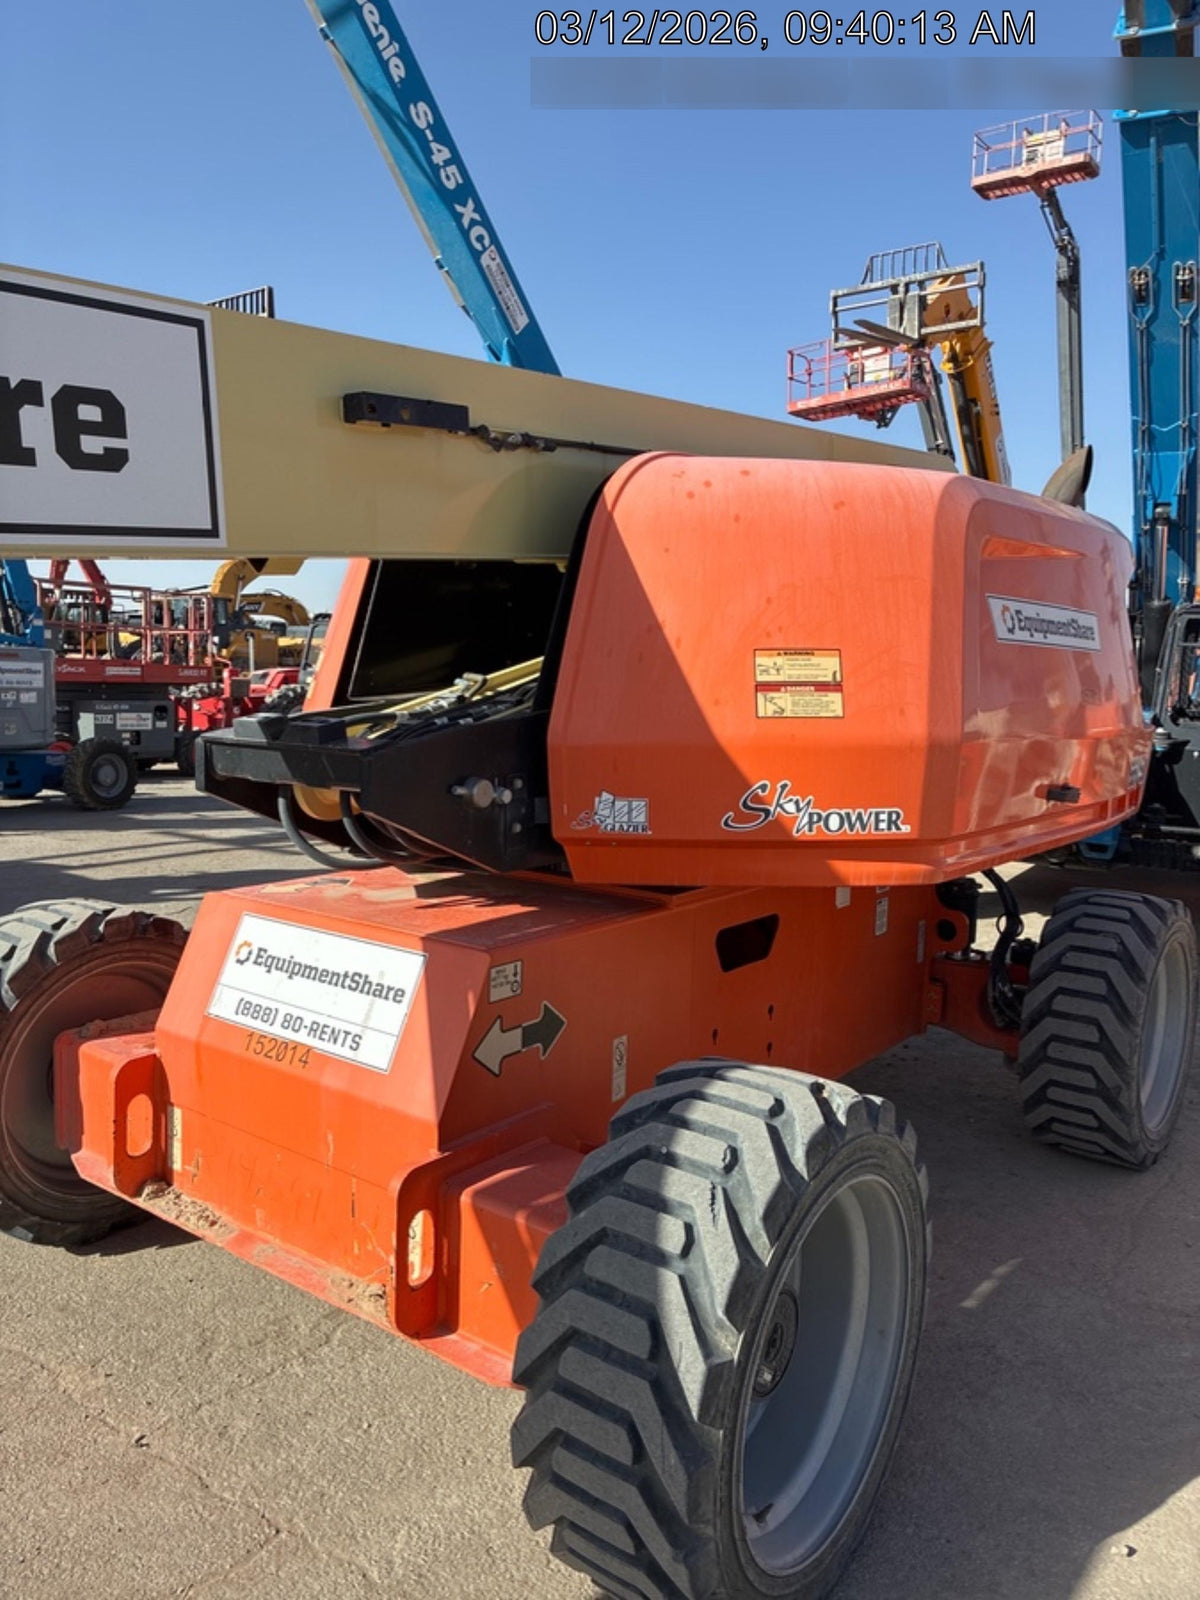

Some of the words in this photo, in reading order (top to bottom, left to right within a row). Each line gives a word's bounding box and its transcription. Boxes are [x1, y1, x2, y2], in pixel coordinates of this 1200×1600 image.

[356, 0, 406, 84] enie
[409, 101, 464, 191] S-45
[454, 197, 491, 252] XC
[1014, 608, 1096, 642] EquipmentShare
[252, 946, 406, 1005] EquipmentShare
[234, 997, 280, 1027] (888)
[280, 1012, 363, 1053] 80-RENTS
[244, 1030, 312, 1070] 152014
